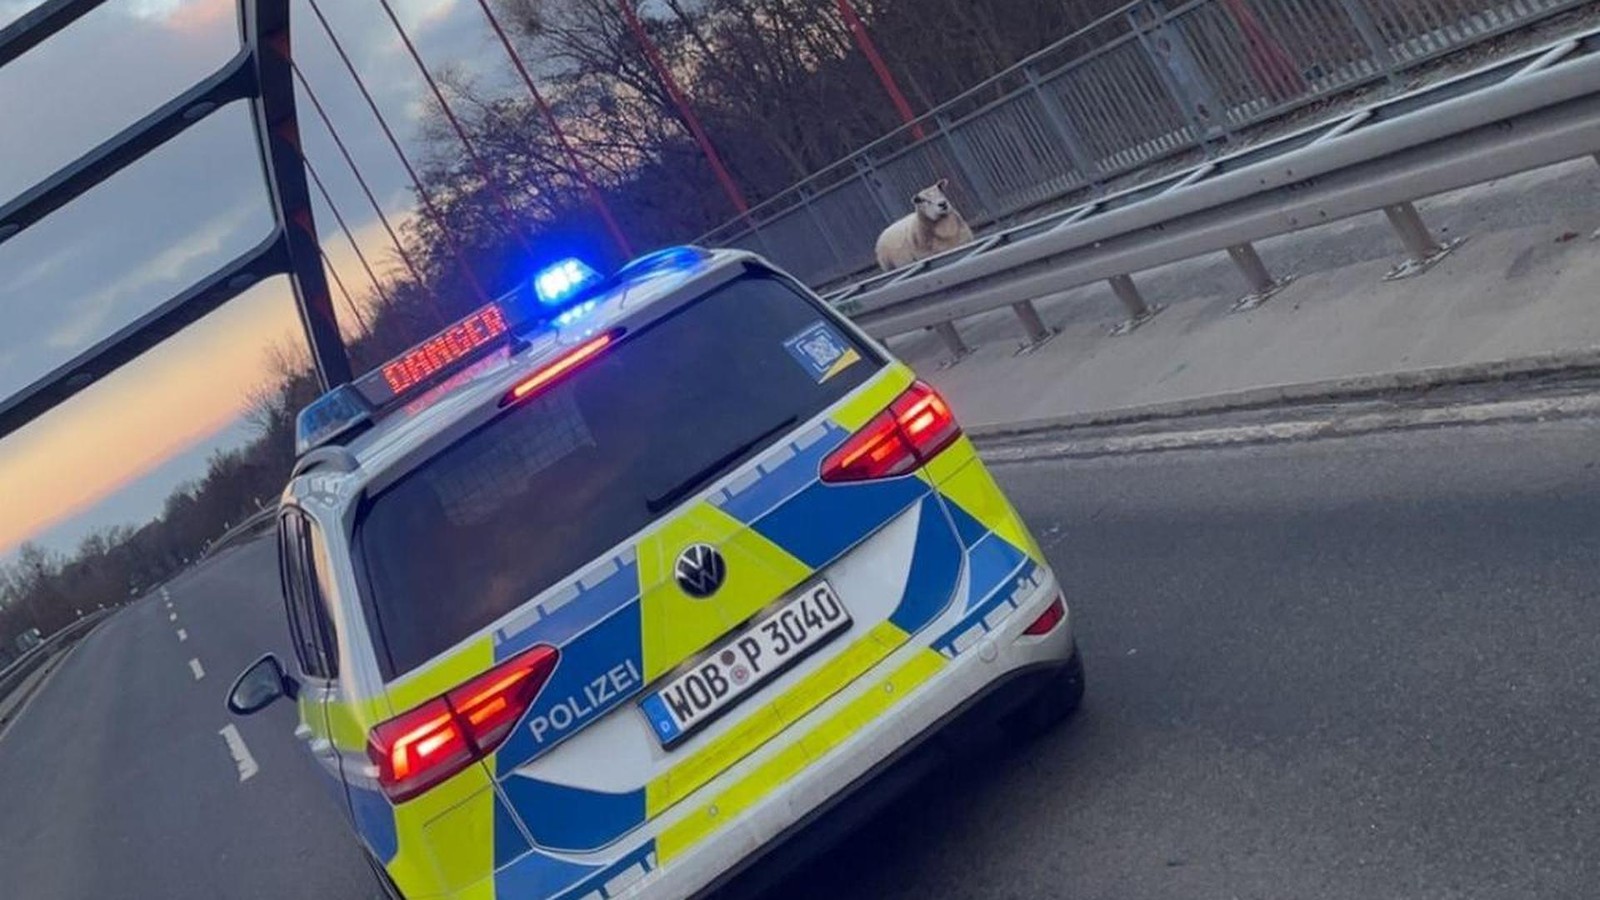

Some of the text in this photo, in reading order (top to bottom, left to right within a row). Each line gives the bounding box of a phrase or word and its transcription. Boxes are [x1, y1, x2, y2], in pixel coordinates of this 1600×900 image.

[382, 304, 508, 395] DANGER
[528, 658, 640, 743] POLIZEI
[663, 588, 841, 722] WOB P 3040
